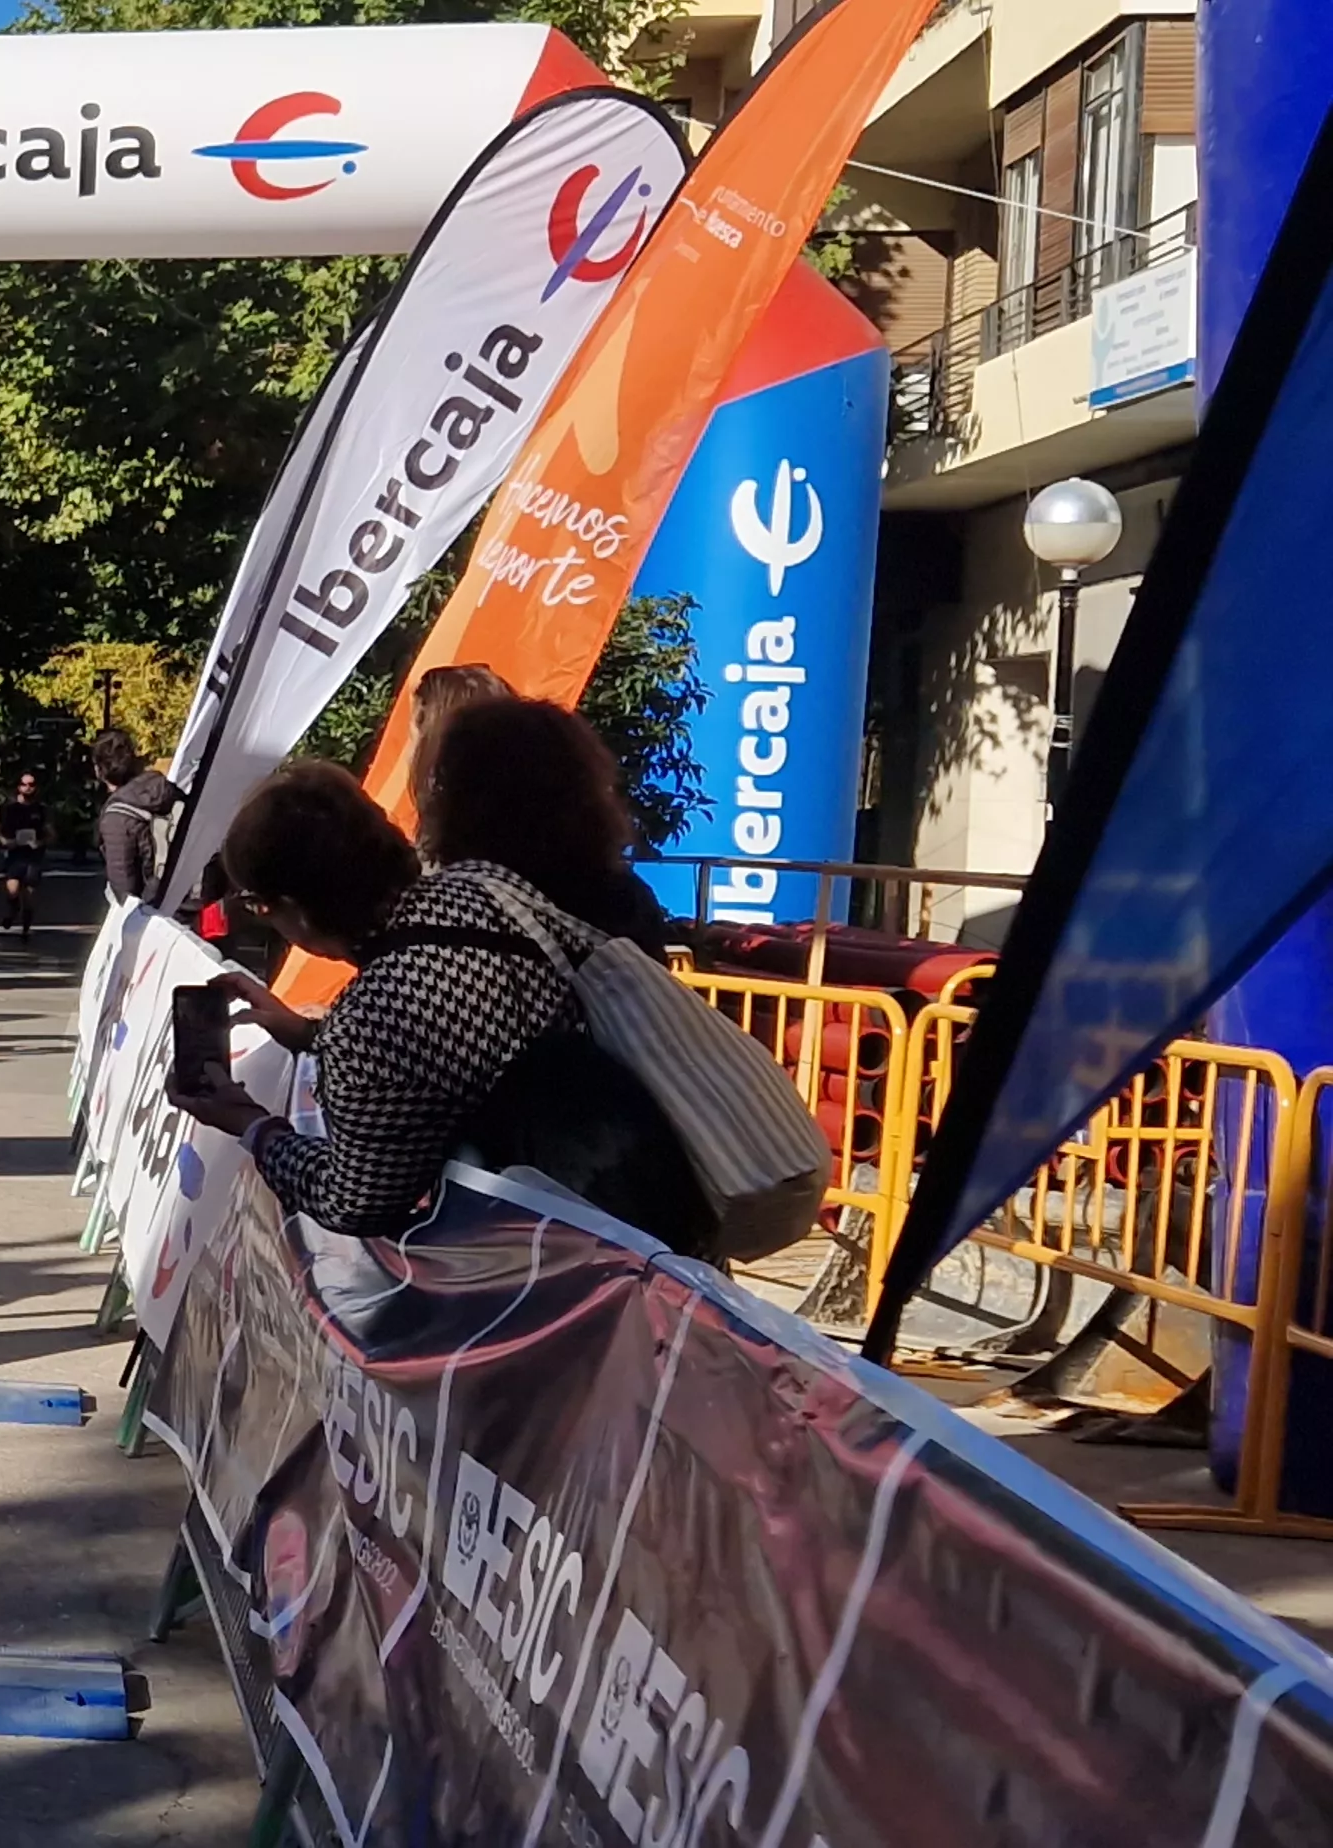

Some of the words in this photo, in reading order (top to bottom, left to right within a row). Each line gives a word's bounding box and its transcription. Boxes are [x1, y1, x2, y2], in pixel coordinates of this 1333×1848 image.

[278, 323, 543, 660] Ibercaja
[712, 615, 807, 926] Ibercaja
[474, 1480, 583, 1705] ESIC
